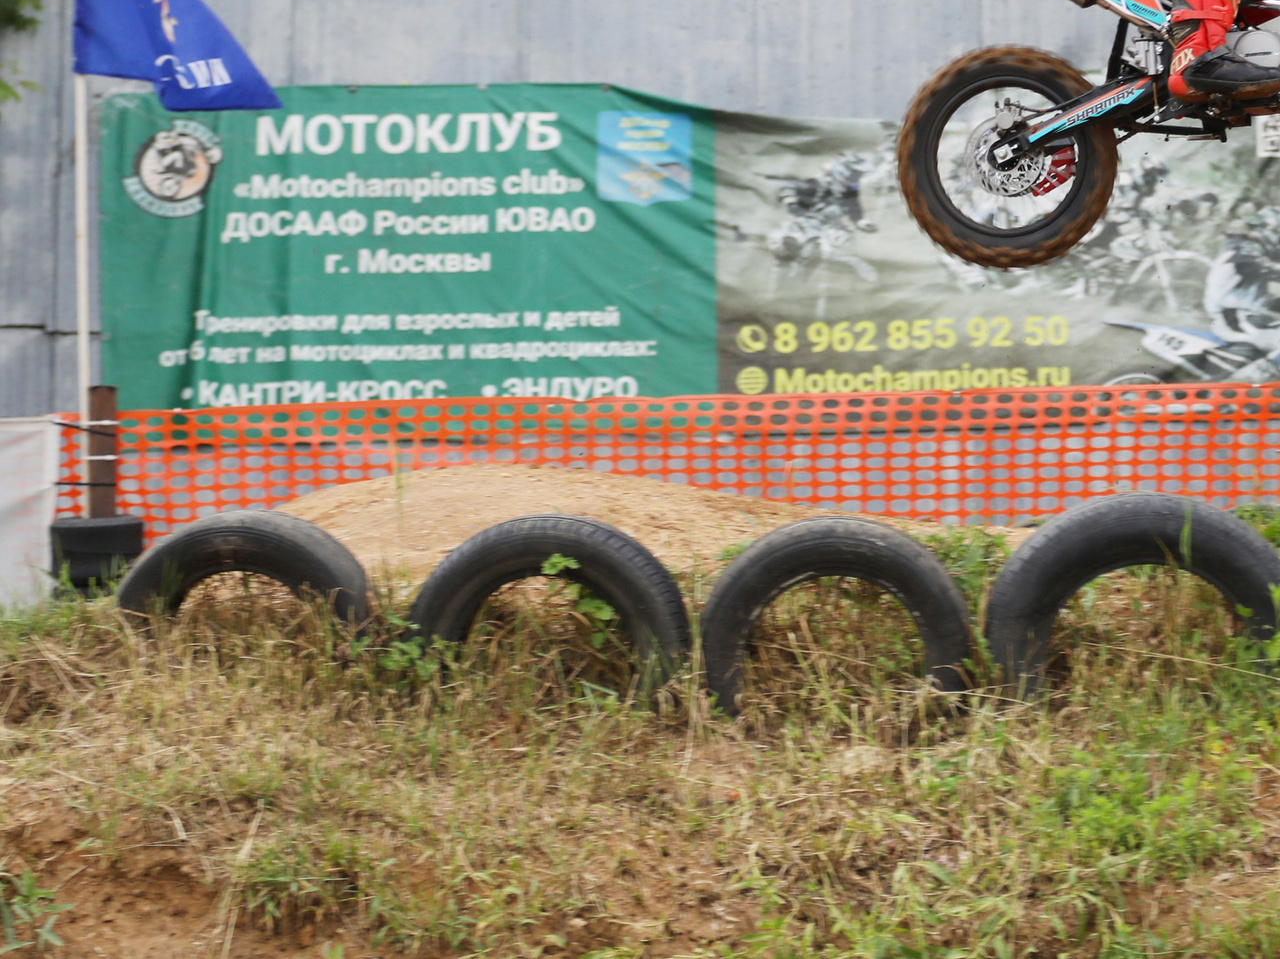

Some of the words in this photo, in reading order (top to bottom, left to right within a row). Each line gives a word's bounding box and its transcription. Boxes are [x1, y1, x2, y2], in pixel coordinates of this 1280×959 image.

[1170, 48, 1195, 75] FOX
[1065, 86, 1135, 126] SHARMAX
[255, 112, 562, 156] МОТОКЛУБ
[234, 171, 497, 203] «Motochampions
[502, 168, 585, 194] club»
[221, 210, 367, 243] ДОСААФ
[373, 209, 489, 236] России
[495, 206, 596, 233] ЮВАО
[324, 253, 350, 275] г.
[357, 248, 491, 275] Москвы
[194, 310, 338, 338] Тренировки
[341, 313, 392, 334] для
[395, 311, 519, 335] взрослых
[523, 311, 541, 327] и
[543, 306, 621, 331] детей
[773, 322, 799, 353] 8
[807, 320, 879, 353] 962
[887, 318, 957, 351] 855
[967, 316, 1014, 349] 92
[1024, 315, 1070, 347] 50
[159, 350, 188, 367] от
[189, 339, 206, 362] 6
[207, 346, 252, 364] лет
[255, 345, 287, 363] на
[290, 343, 444, 364] мотоциклах
[447, 343, 465, 360] и
[469, 339, 658, 362] квадроциклах:
[197, 379, 447, 407] КАНТРИ-КРОСС
[502, 376, 639, 401] ЭНДУРО
[774, 363, 1071, 394] Motochampions.ru
